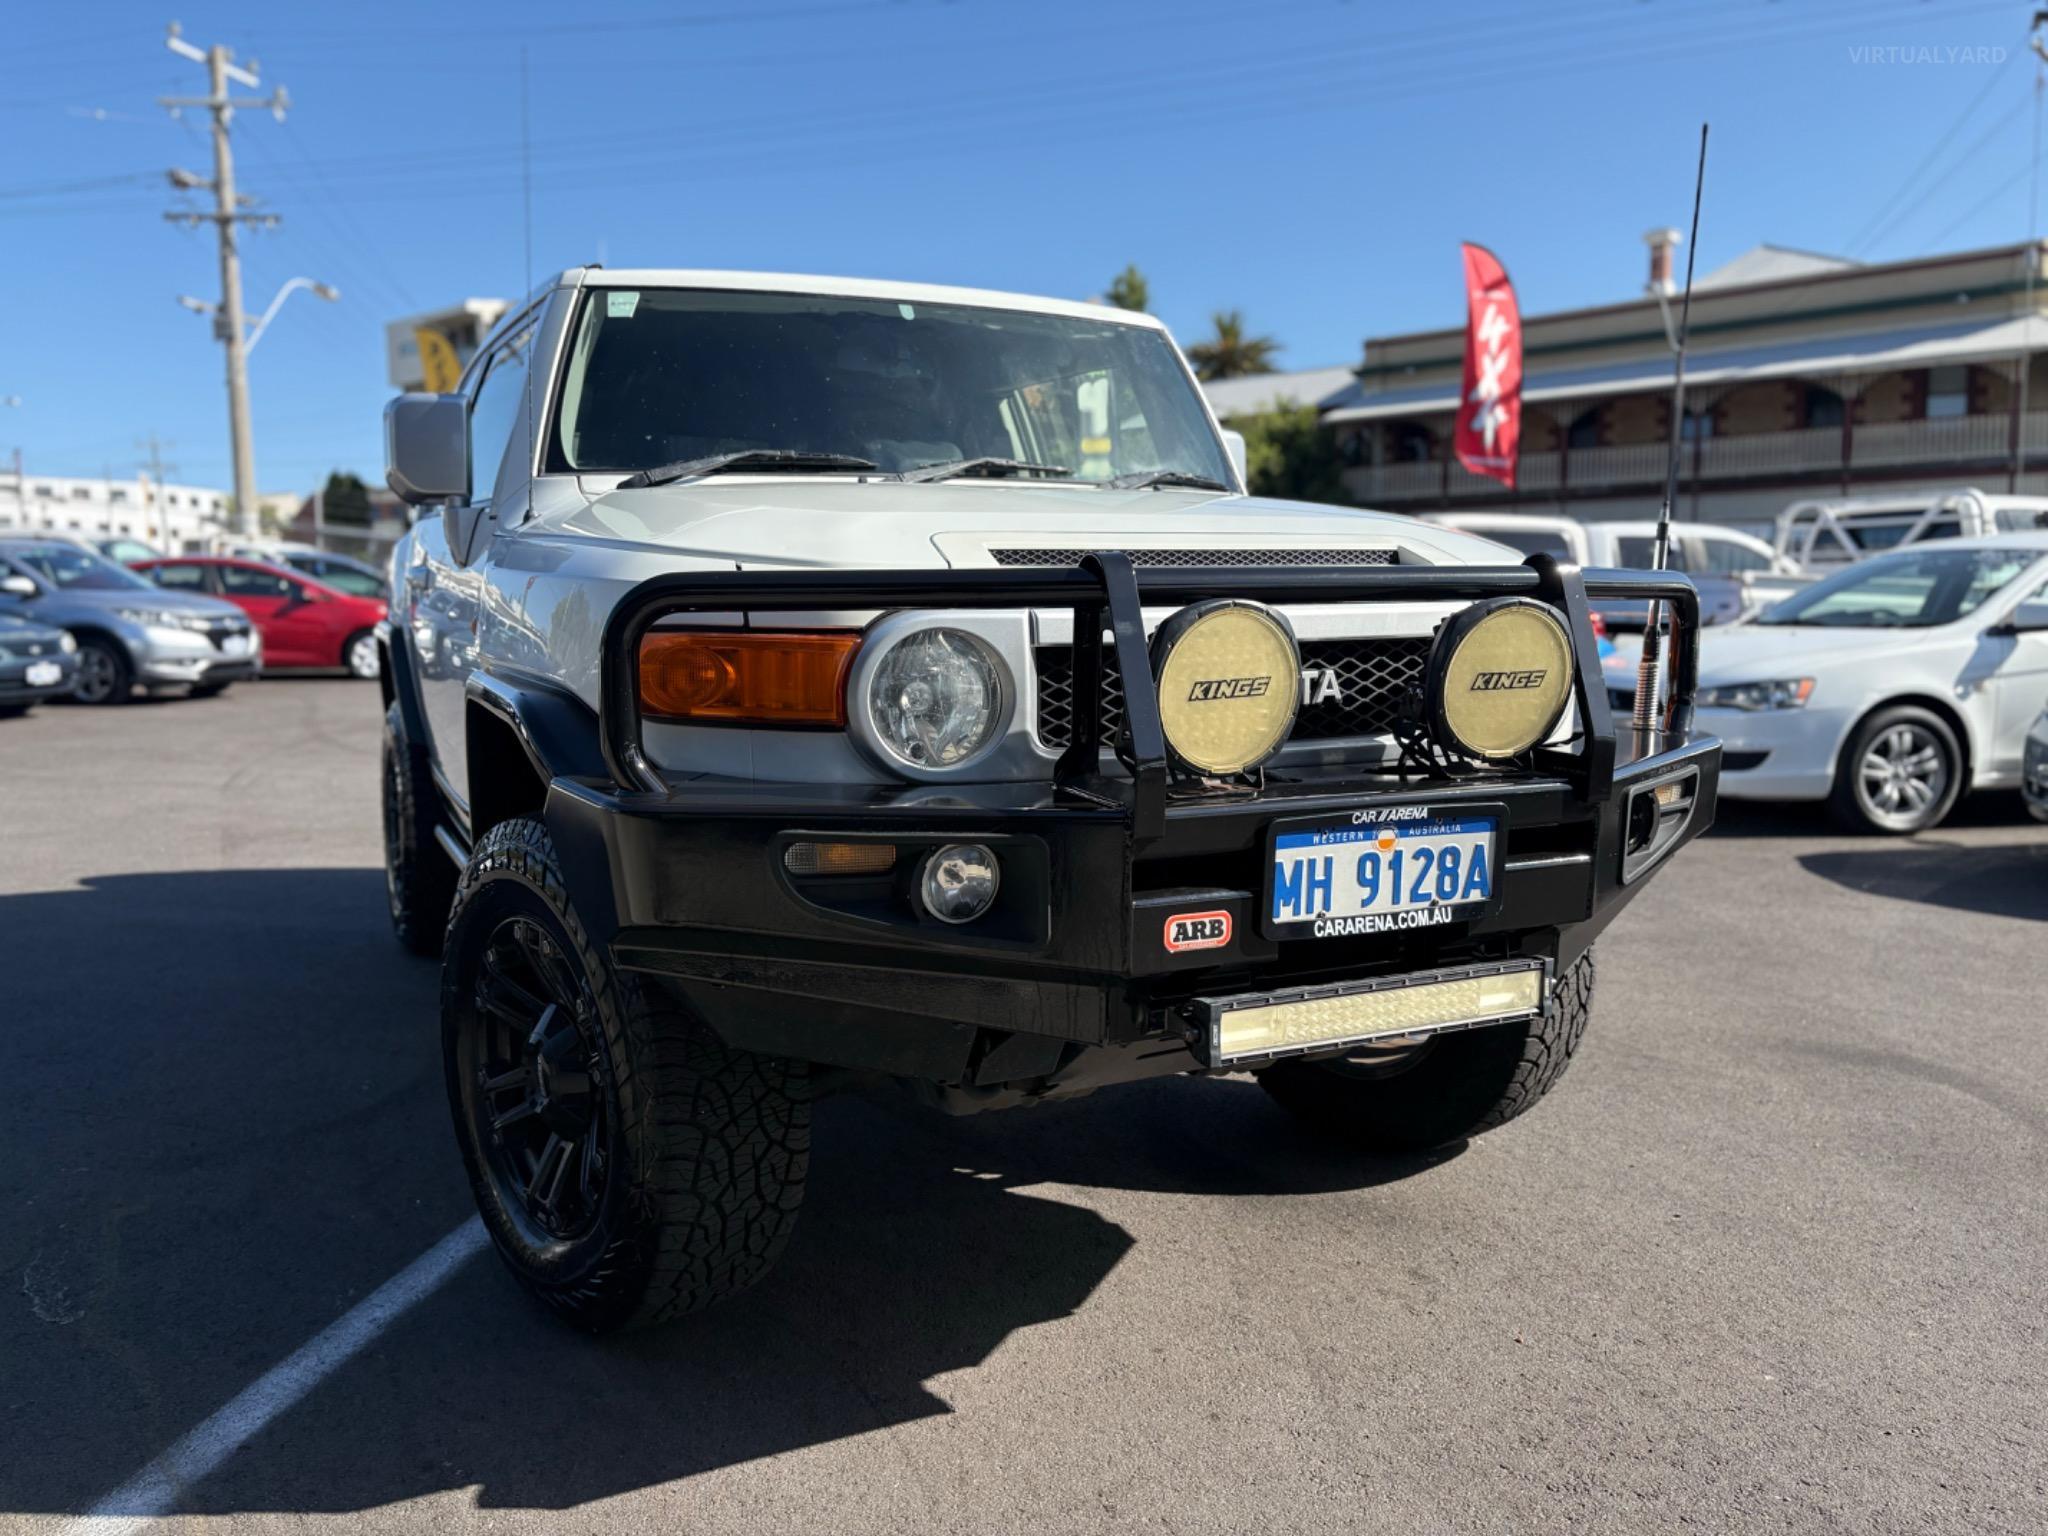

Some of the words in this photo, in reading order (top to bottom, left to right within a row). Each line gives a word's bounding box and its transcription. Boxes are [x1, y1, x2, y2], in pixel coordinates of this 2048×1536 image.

[1190, 677, 1271, 701] KINGS
[1471, 670, 1547, 690] KINGS
[1313, 831, 1364, 844] WESTERN
[1409, 824, 1461, 836] AUSTRALIA
[1273, 856, 1333, 918] MH
[1356, 844, 1490, 909] 9128A
[1173, 919, 1224, 943] ARB
[1314, 907, 1452, 937] CARARENA.COM.AU
